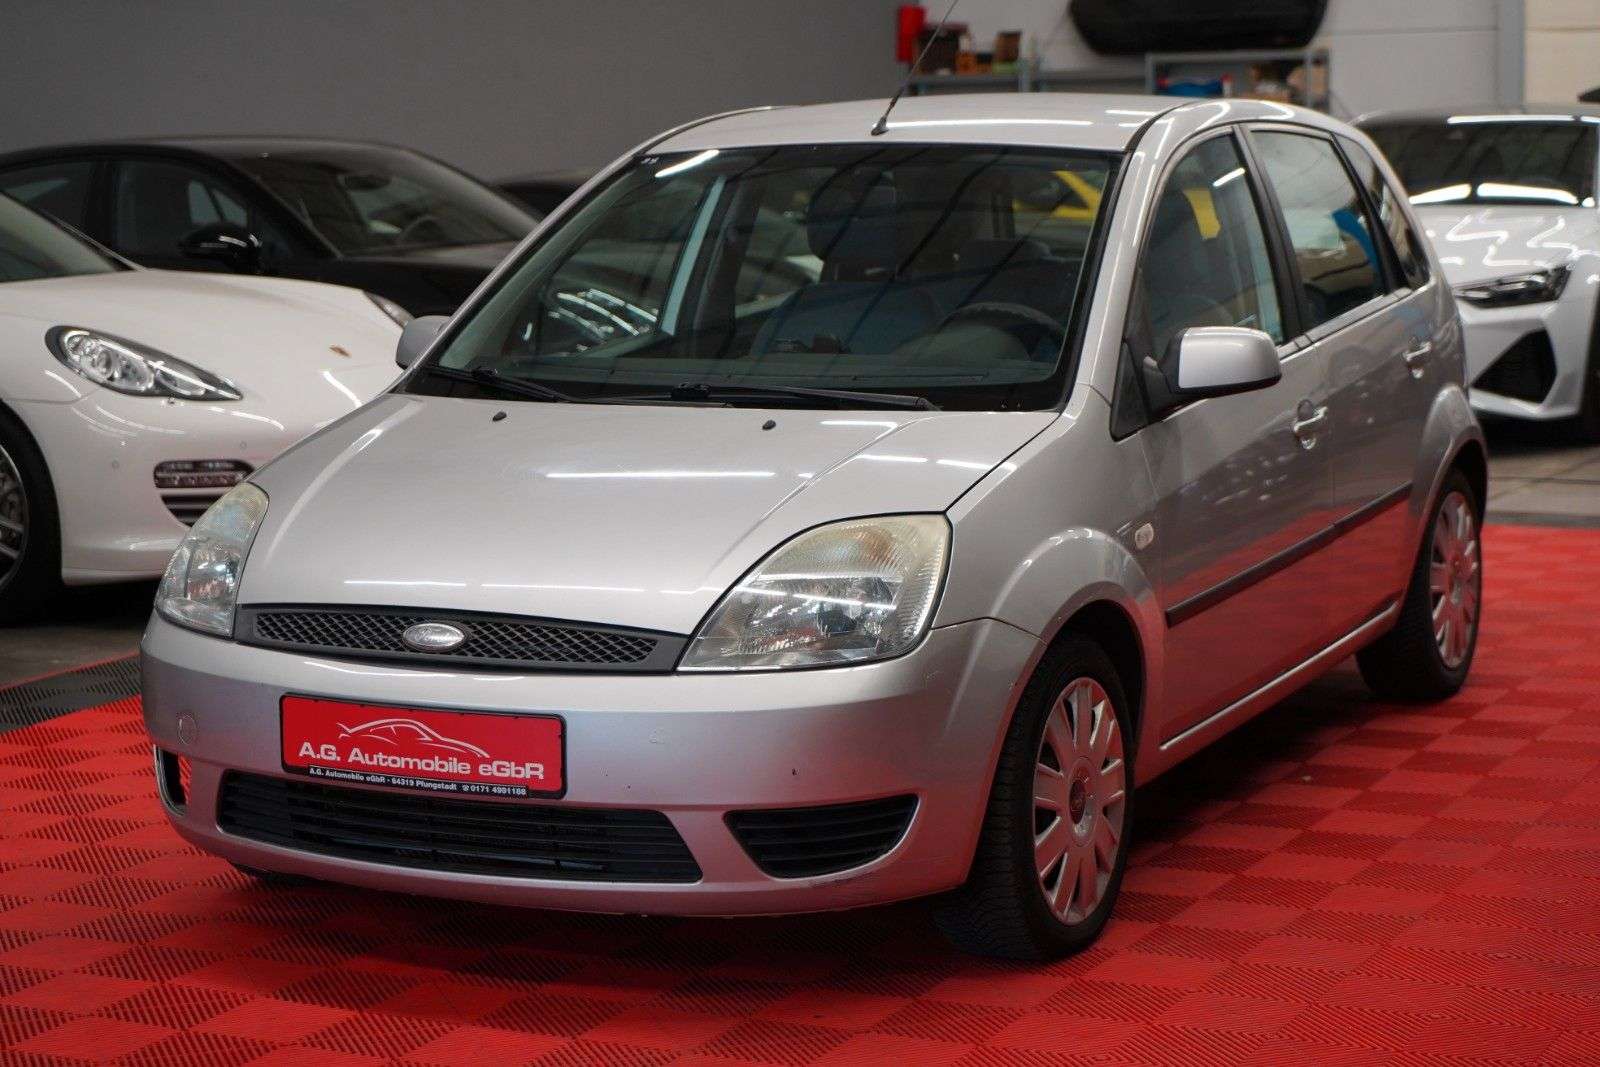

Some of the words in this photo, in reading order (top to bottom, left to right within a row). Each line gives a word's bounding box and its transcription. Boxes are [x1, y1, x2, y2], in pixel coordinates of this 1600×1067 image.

[299, 742, 341, 761] A.G.
[348, 747, 471, 775] Automobile
[478, 760, 544, 780] eGbR
[309, 767, 324, 776] A.G.
[325, 769, 365, 781] Automobile
[470, 784, 489, 793] 0171
